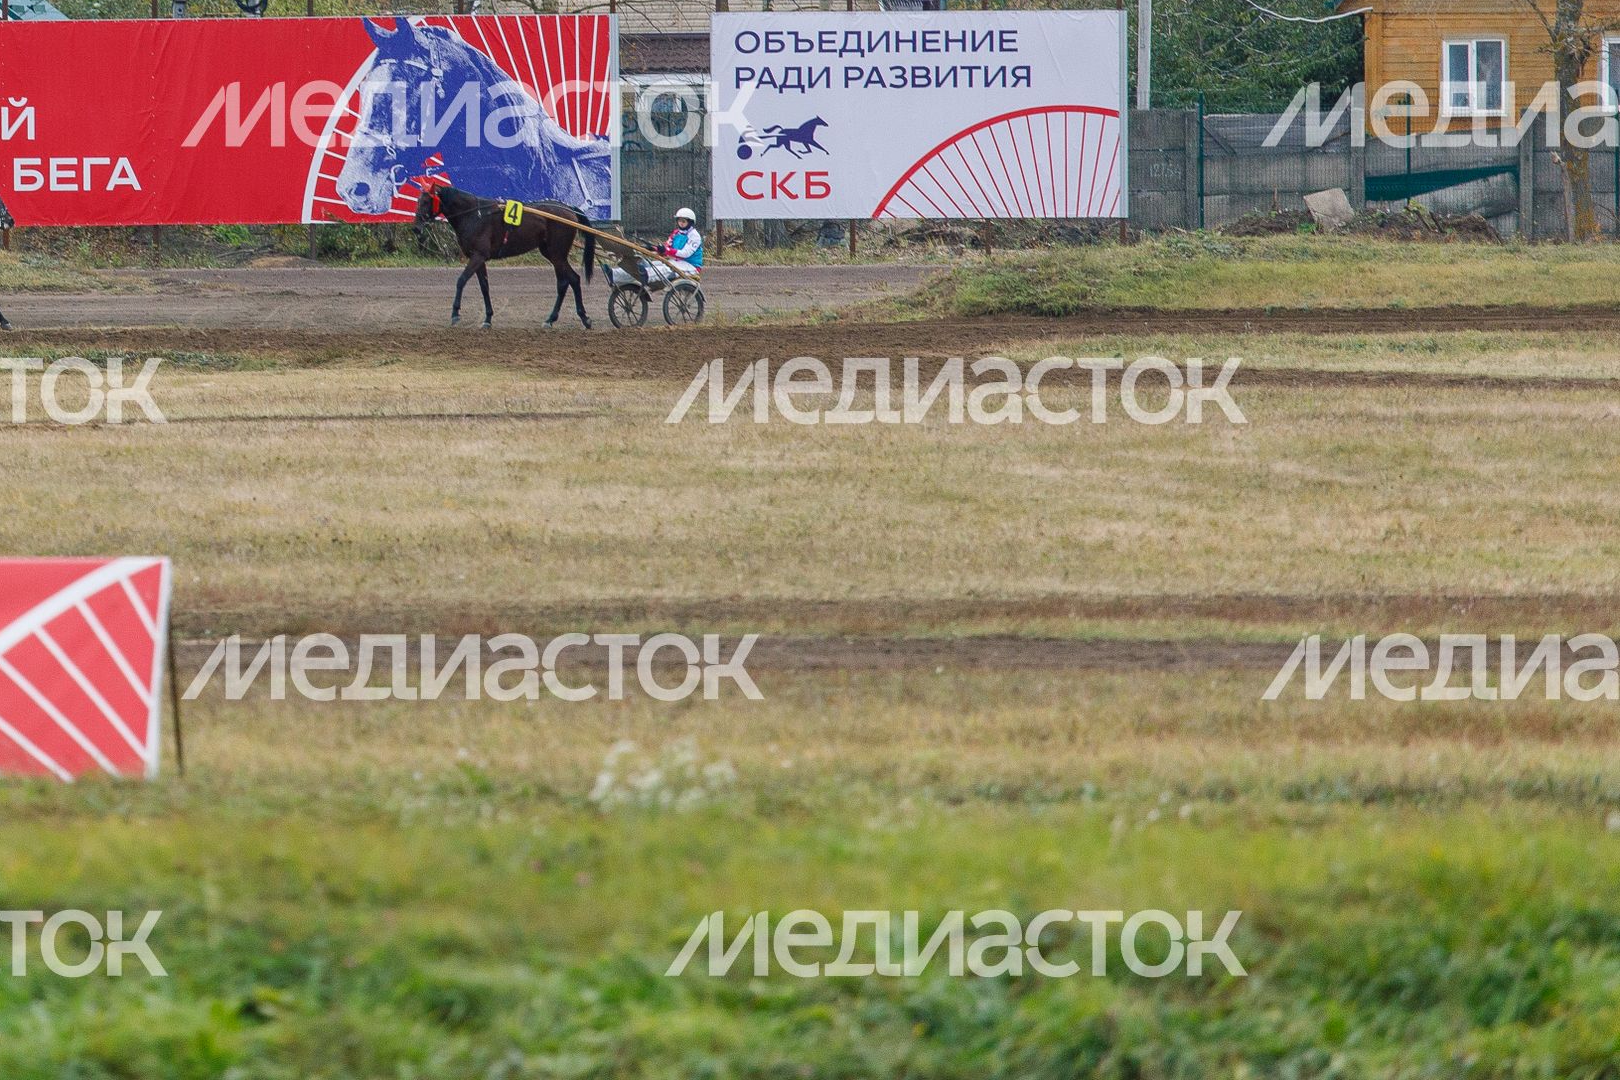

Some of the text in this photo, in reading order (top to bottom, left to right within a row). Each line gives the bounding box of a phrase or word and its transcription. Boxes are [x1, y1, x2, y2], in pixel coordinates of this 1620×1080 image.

[734, 29, 1019, 58] ОБЪЕДИНЕНИЕ
[735, 65, 1032, 94] РАДИ РАЗВИТИЯ
[13, 157, 143, 191] БЕГА
[736, 171, 831, 200] СКБ
